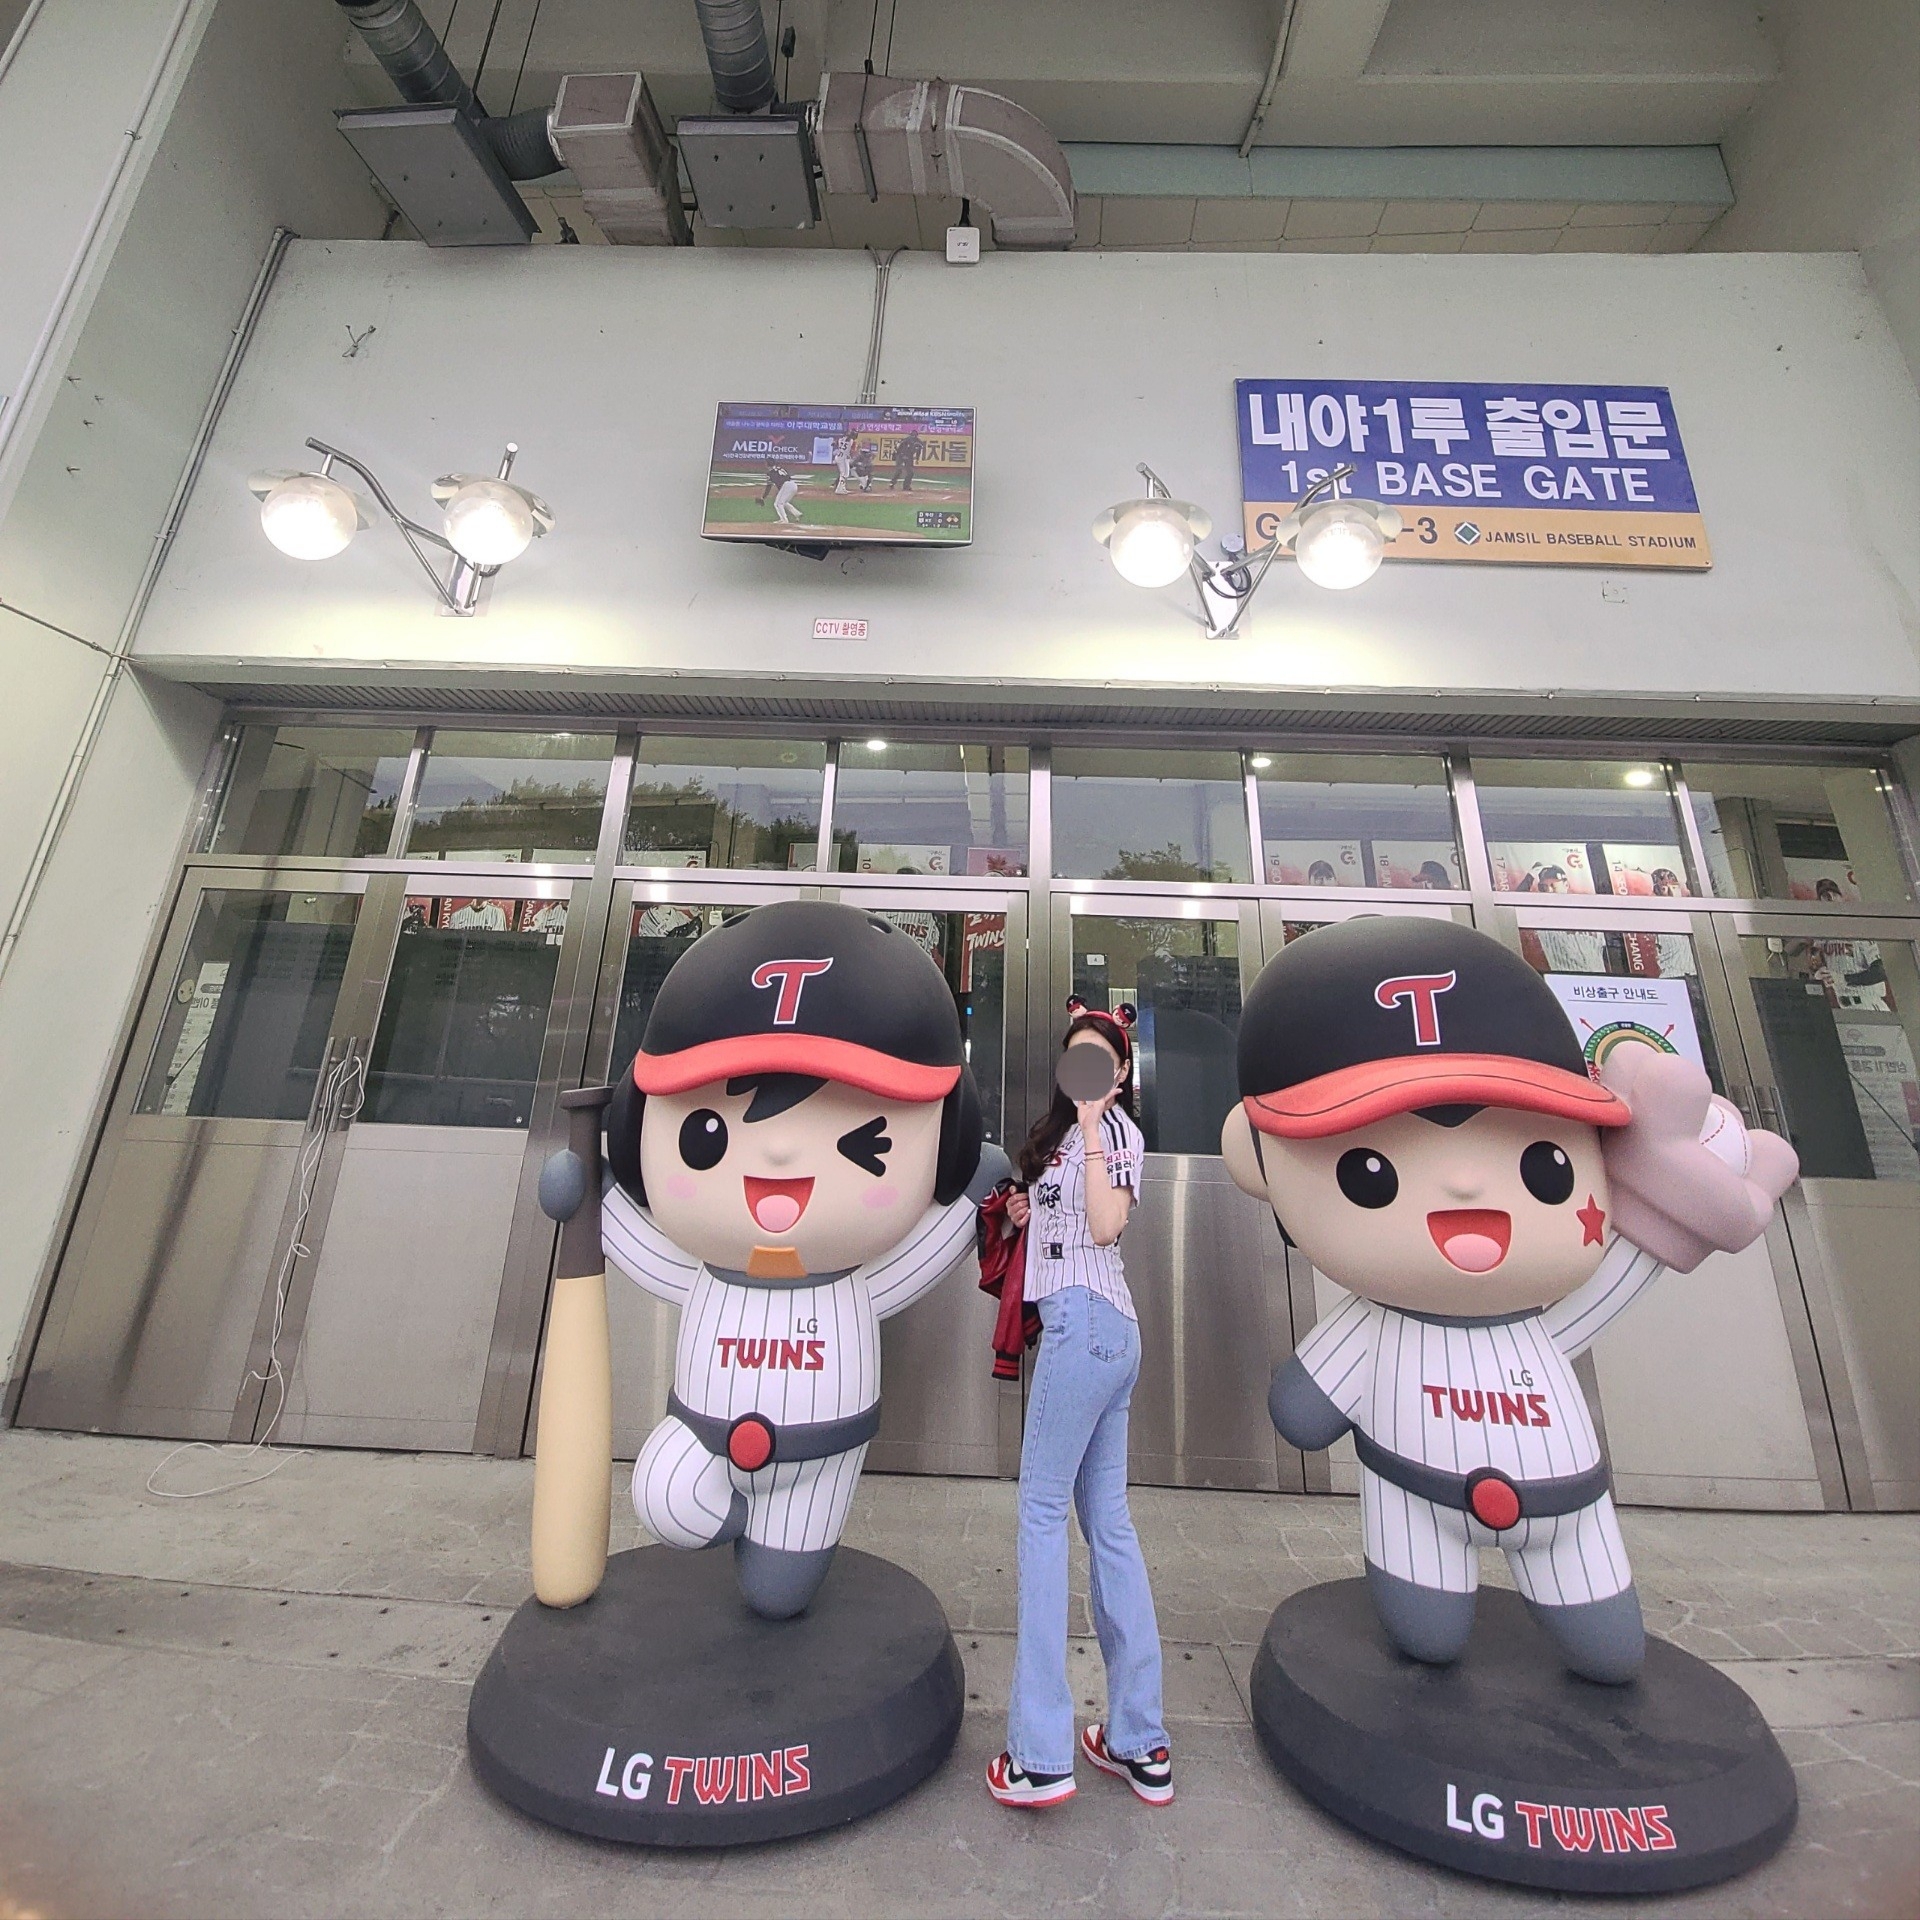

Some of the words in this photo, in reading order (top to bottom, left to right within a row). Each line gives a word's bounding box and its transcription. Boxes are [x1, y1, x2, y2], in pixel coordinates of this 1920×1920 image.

[1249, 393, 1470, 455] 내야1루
[1485, 397, 1670, 459] 출입문
[1282, 460, 1353, 494] 1st
[1376, 461, 1502, 498] BASE
[1523, 465, 1655, 502] GATE
[1485, 530, 1541, 545] JAMSIL
[1546, 532, 1622, 547] BASEBALL
[1628, 534, 1697, 549] STADIUM
[815, 622, 840, 634] CCTV
[842, 622, 866, 636] 촬영중
[1496, 857, 1506, 869] 17
[752, 957, 834, 1025] T
[1374, 970, 1457, 1046] T
[1573, 986, 1619, 999] 비상출구
[1623, 987, 1659, 1001] 안내도
[797, 1318, 818, 1334] LG
[717, 1337, 825, 1371] TWINS
[1509, 1368, 1534, 1387] LG
[1422, 1384, 1551, 1427] TWINS
[595, 1747, 654, 1800] LG
[664, 1744, 810, 1805] TWINS
[1446, 1783, 1505, 1839] LG
[1515, 1800, 1677, 1853] TWINS
